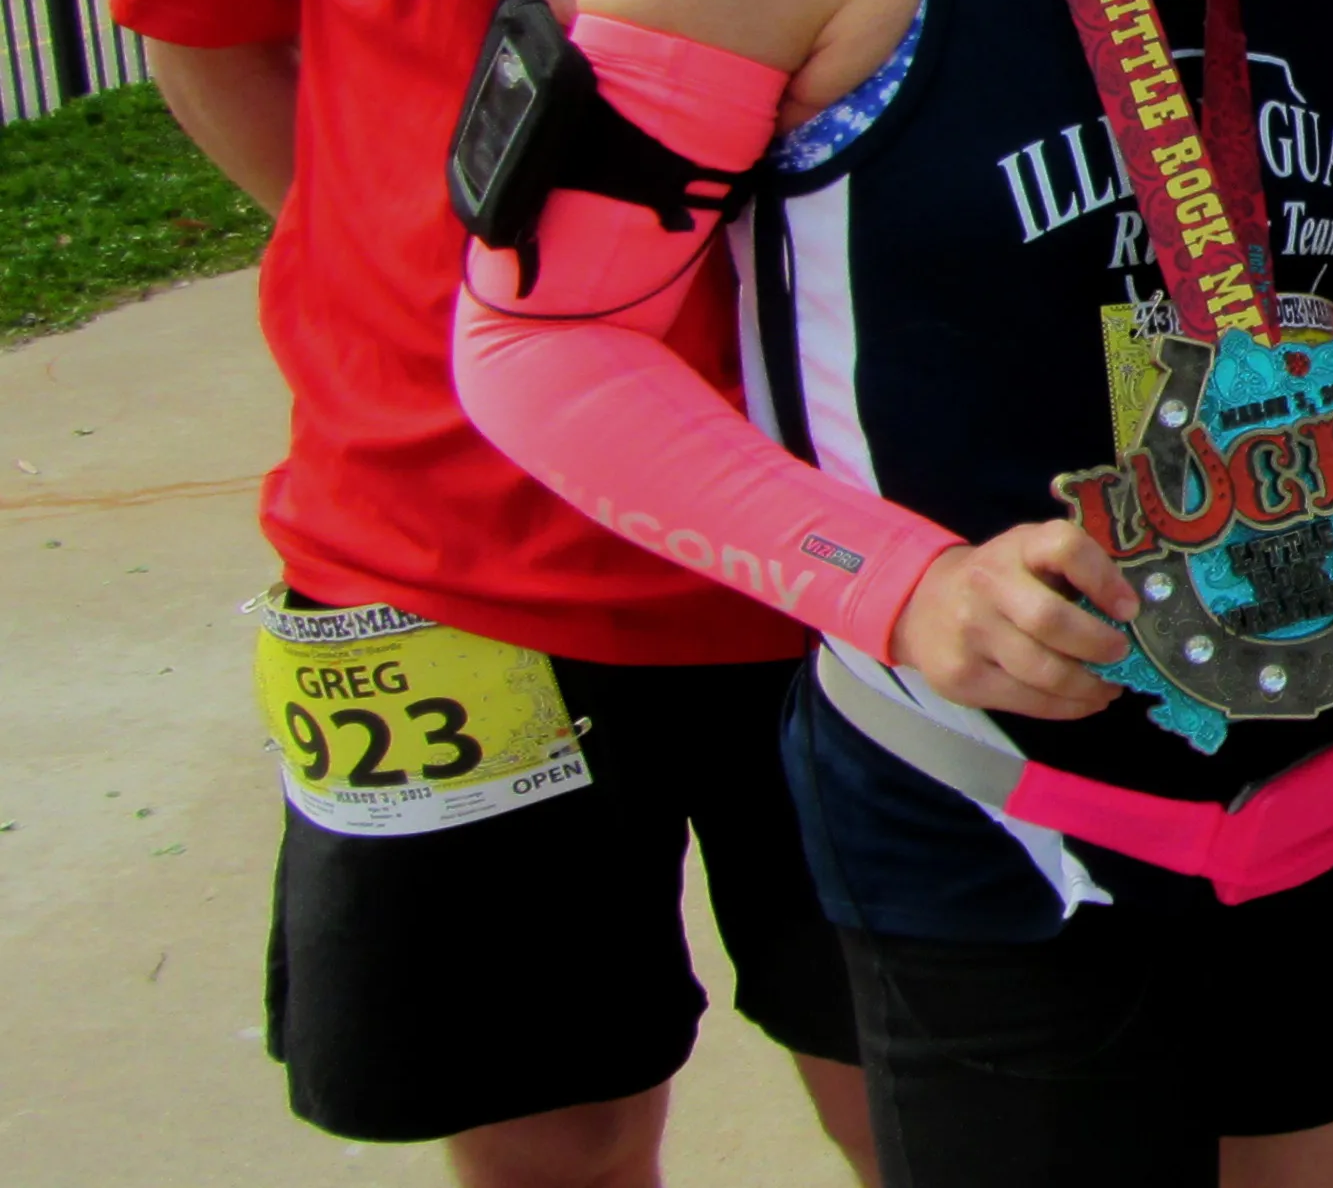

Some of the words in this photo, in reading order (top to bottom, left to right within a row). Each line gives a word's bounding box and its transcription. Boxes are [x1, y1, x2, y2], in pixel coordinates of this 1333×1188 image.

[1152, 133, 1238, 260] ROCK
[294, 613, 349, 639] ROCK
[296, 661, 409, 700] GREG
[285, 697, 483, 787] 923
[512, 760, 583, 796] OPEN
